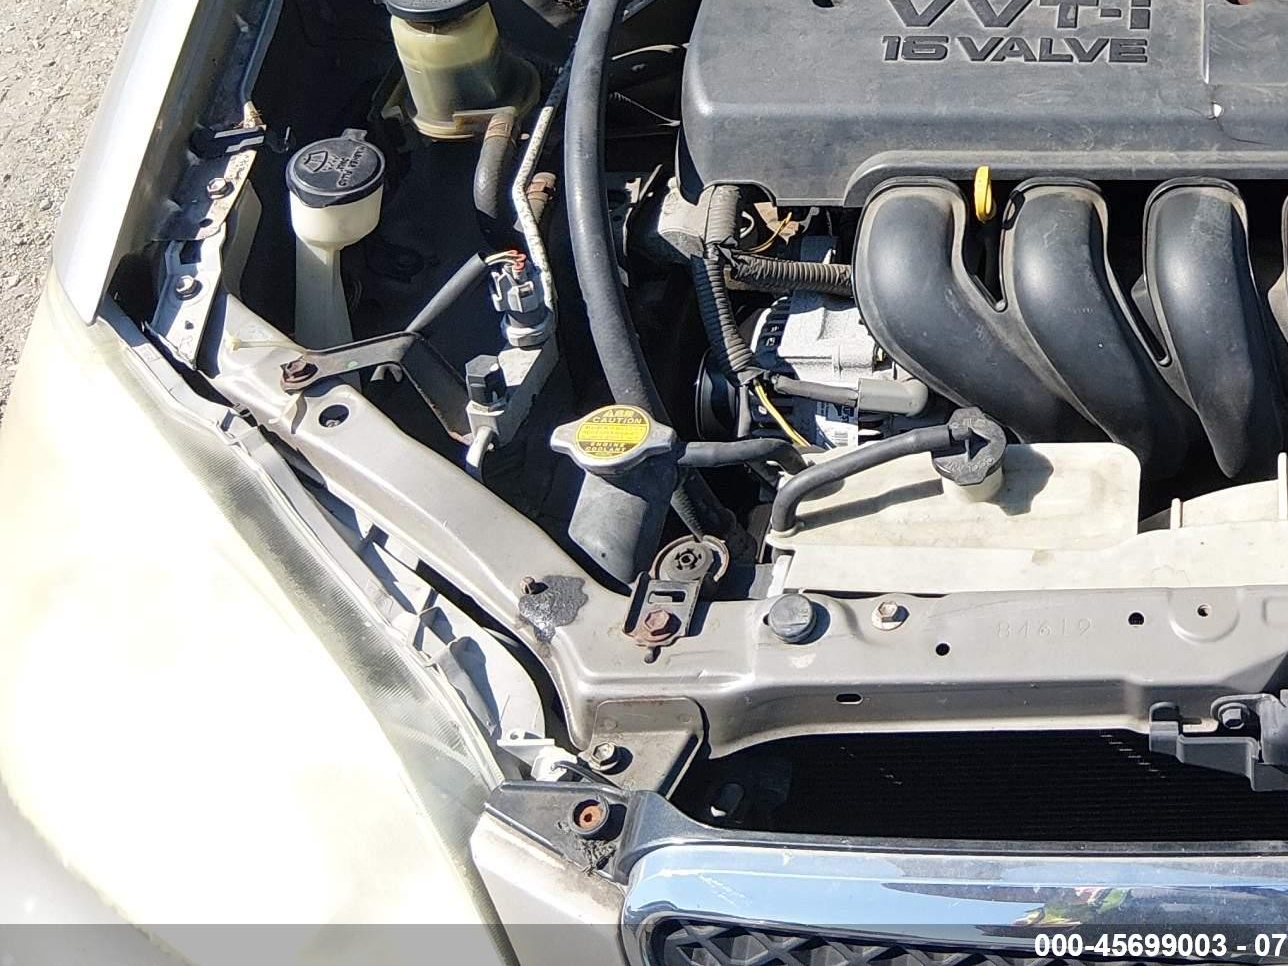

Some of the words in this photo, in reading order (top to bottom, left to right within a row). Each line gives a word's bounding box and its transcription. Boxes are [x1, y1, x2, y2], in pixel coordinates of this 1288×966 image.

[881, 35, 950, 62] 16
[955, 35, 1149, 64] VALVE
[592, 416, 643, 425] CAUTION
